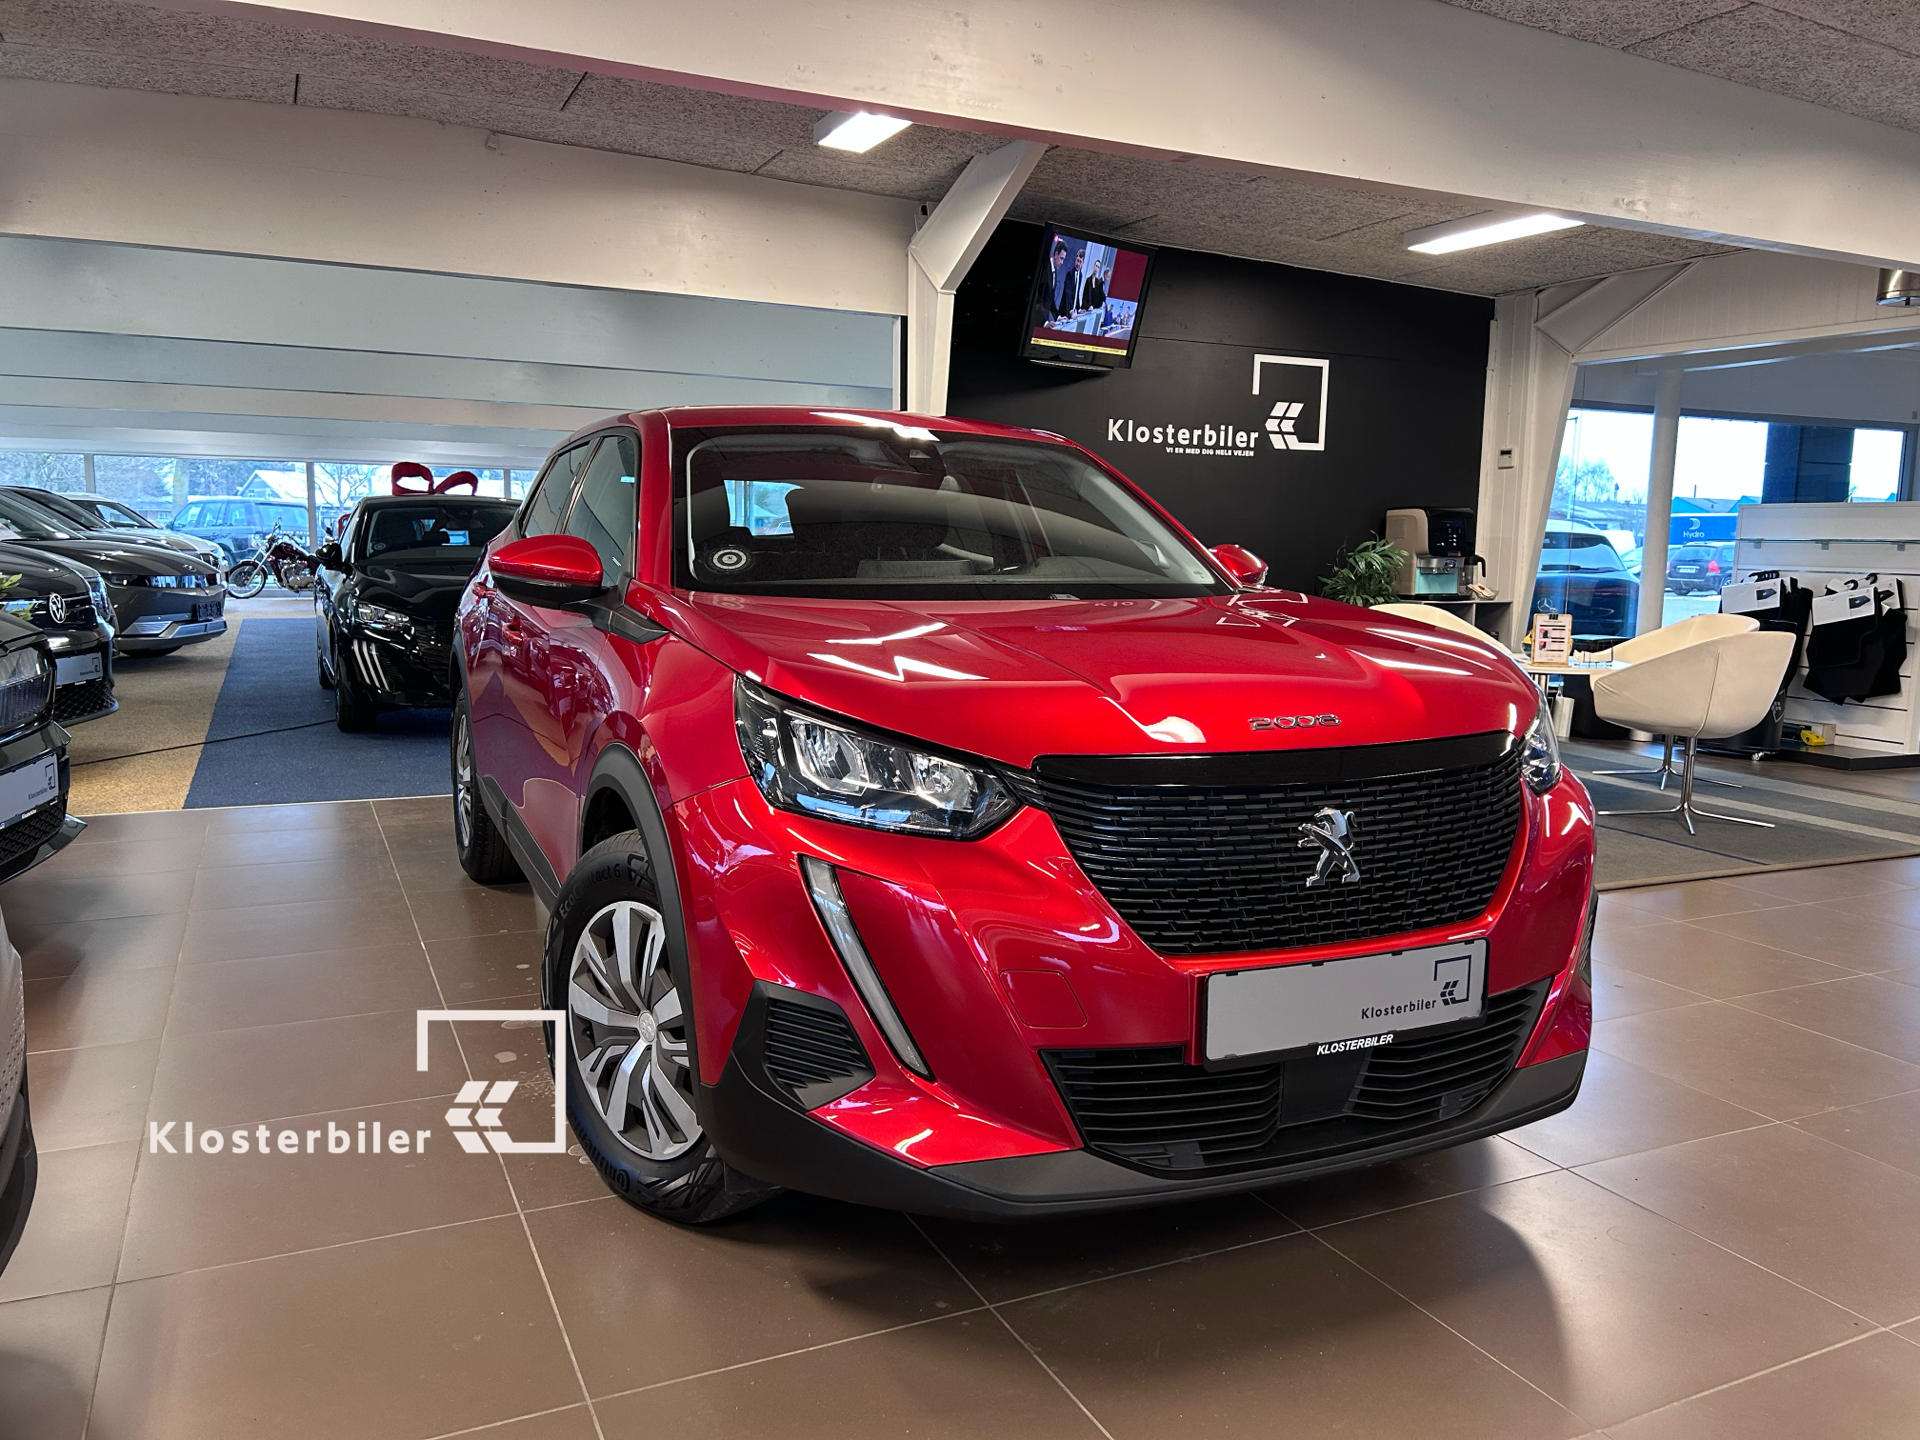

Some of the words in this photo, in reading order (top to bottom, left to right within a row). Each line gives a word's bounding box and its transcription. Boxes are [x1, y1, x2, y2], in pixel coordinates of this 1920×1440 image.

[1107, 418, 1259, 448] Klosterbiler
[1683, 531, 1705, 539] Hydro
[1248, 713, 1342, 731] 2008
[613, 863, 621, 879] 6
[1361, 999, 1437, 1020] Klosterbiler
[1316, 1033, 1394, 1056] KLOSTERBILER
